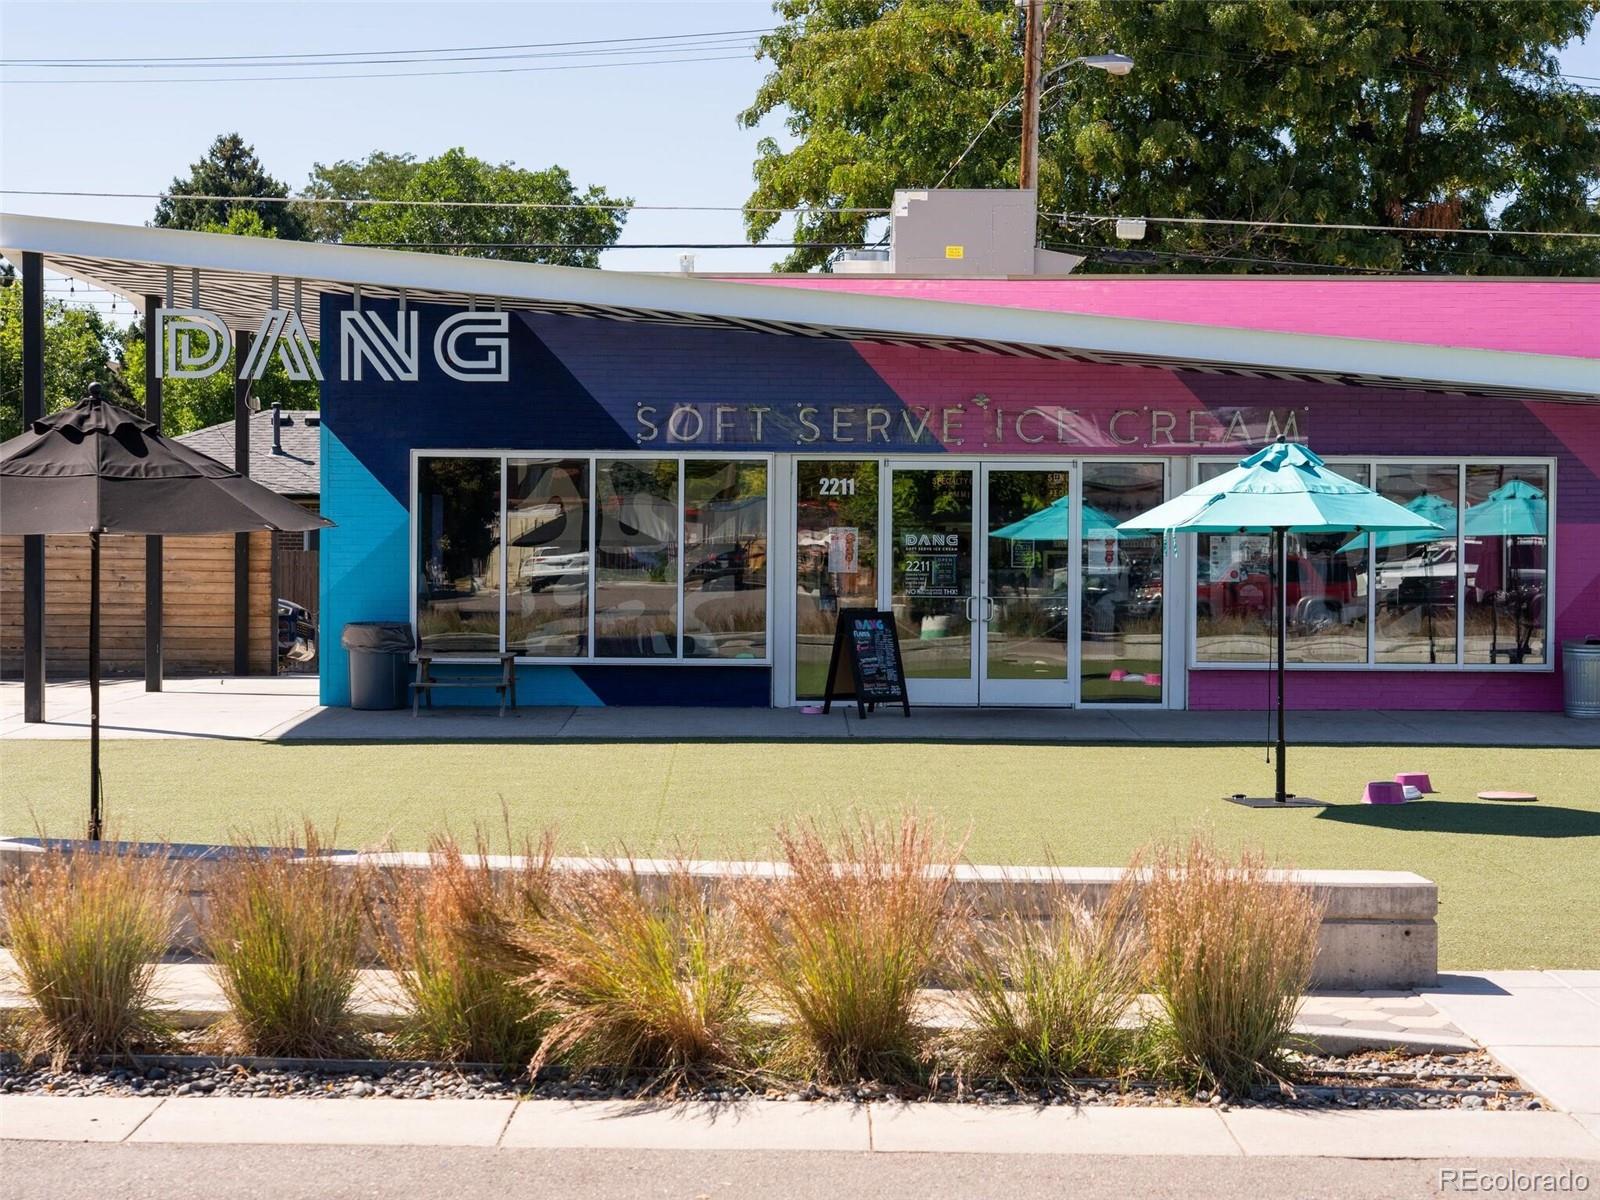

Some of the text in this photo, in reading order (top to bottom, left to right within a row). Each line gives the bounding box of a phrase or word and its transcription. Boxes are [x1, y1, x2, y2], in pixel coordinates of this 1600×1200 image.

[155, 307, 509, 382] DANG
[636, 406, 1299, 444] SOFT SERVE ICE CREAM
[819, 477, 855, 496] 2211
[905, 534, 959, 546] DANG
[905, 560, 930, 572] 2211
